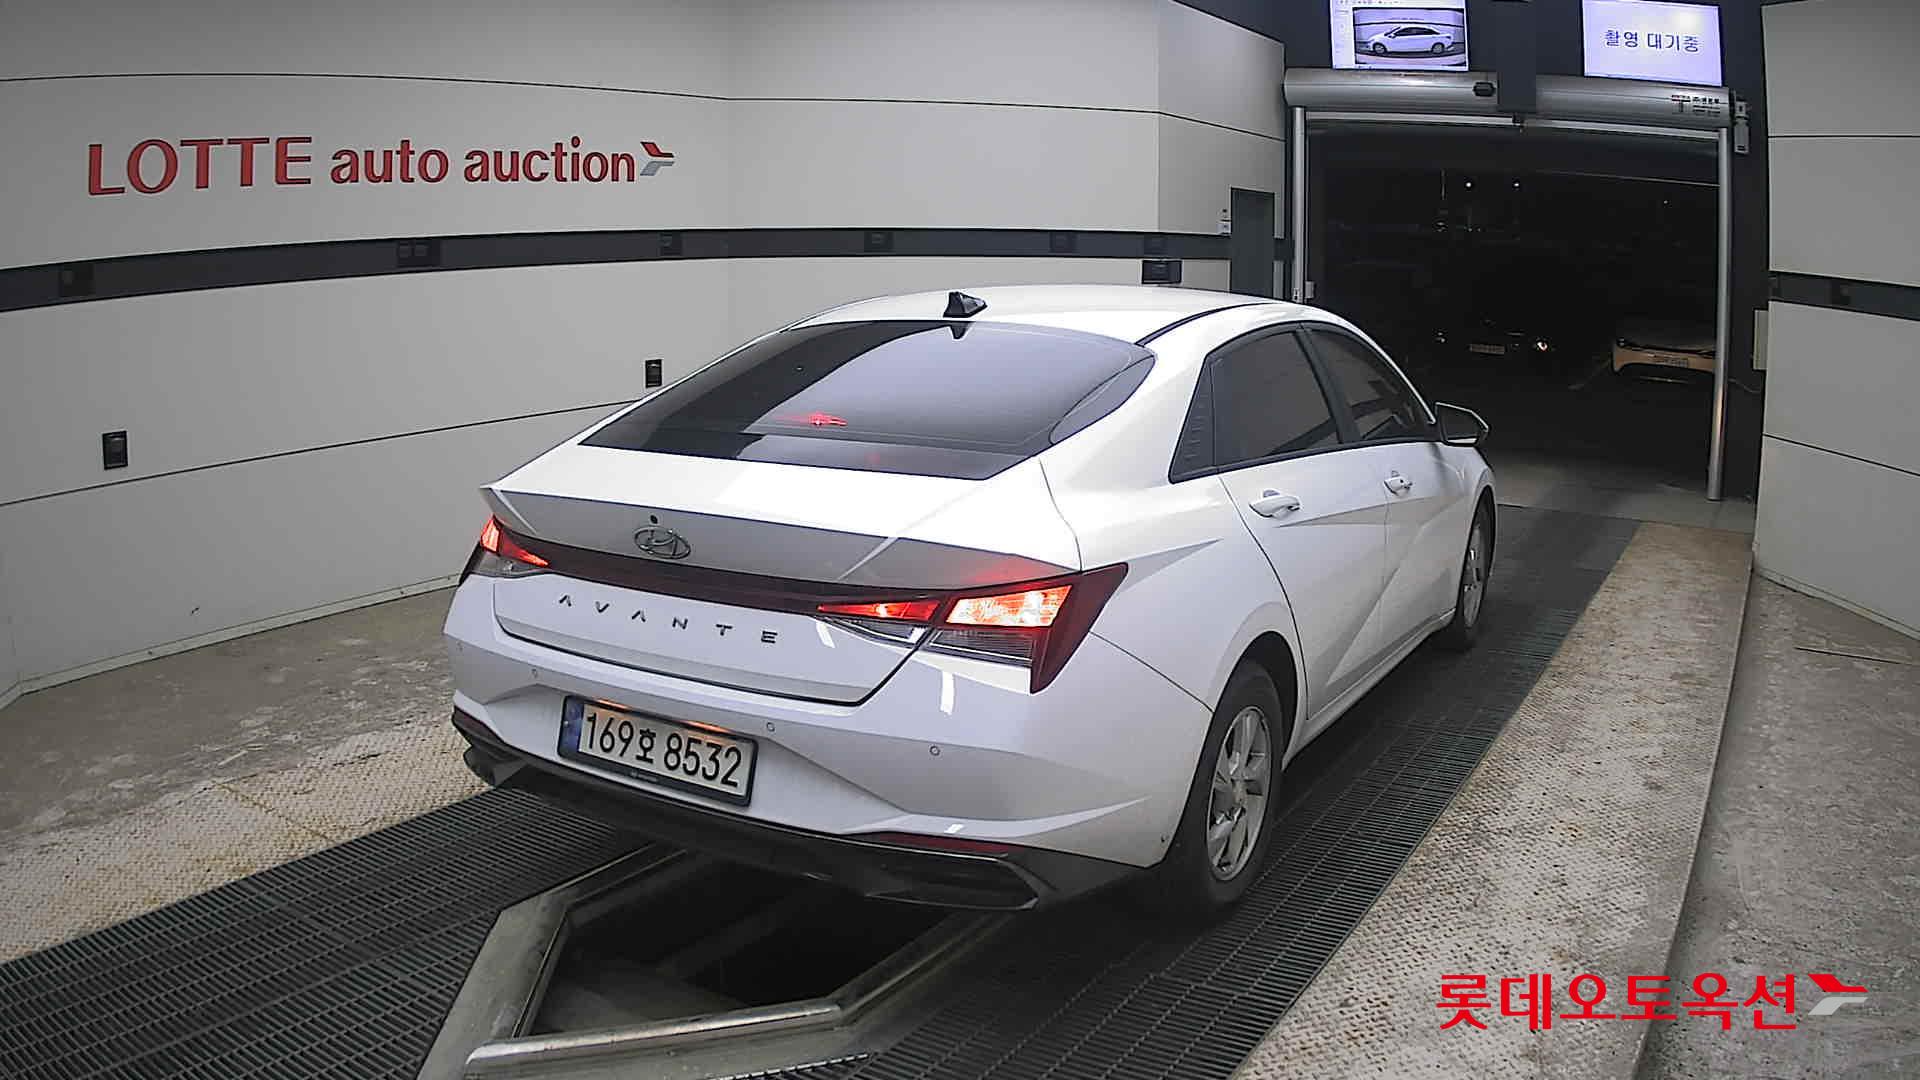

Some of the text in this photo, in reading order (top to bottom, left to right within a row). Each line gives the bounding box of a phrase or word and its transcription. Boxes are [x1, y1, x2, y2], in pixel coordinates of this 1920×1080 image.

[1604, 29, 1700, 53] 촬영 대기중
[88, 136, 636, 196] LOTTE auto auction
[558, 594, 778, 644] AVANTE
[586, 712, 743, 788] 169호 8532
